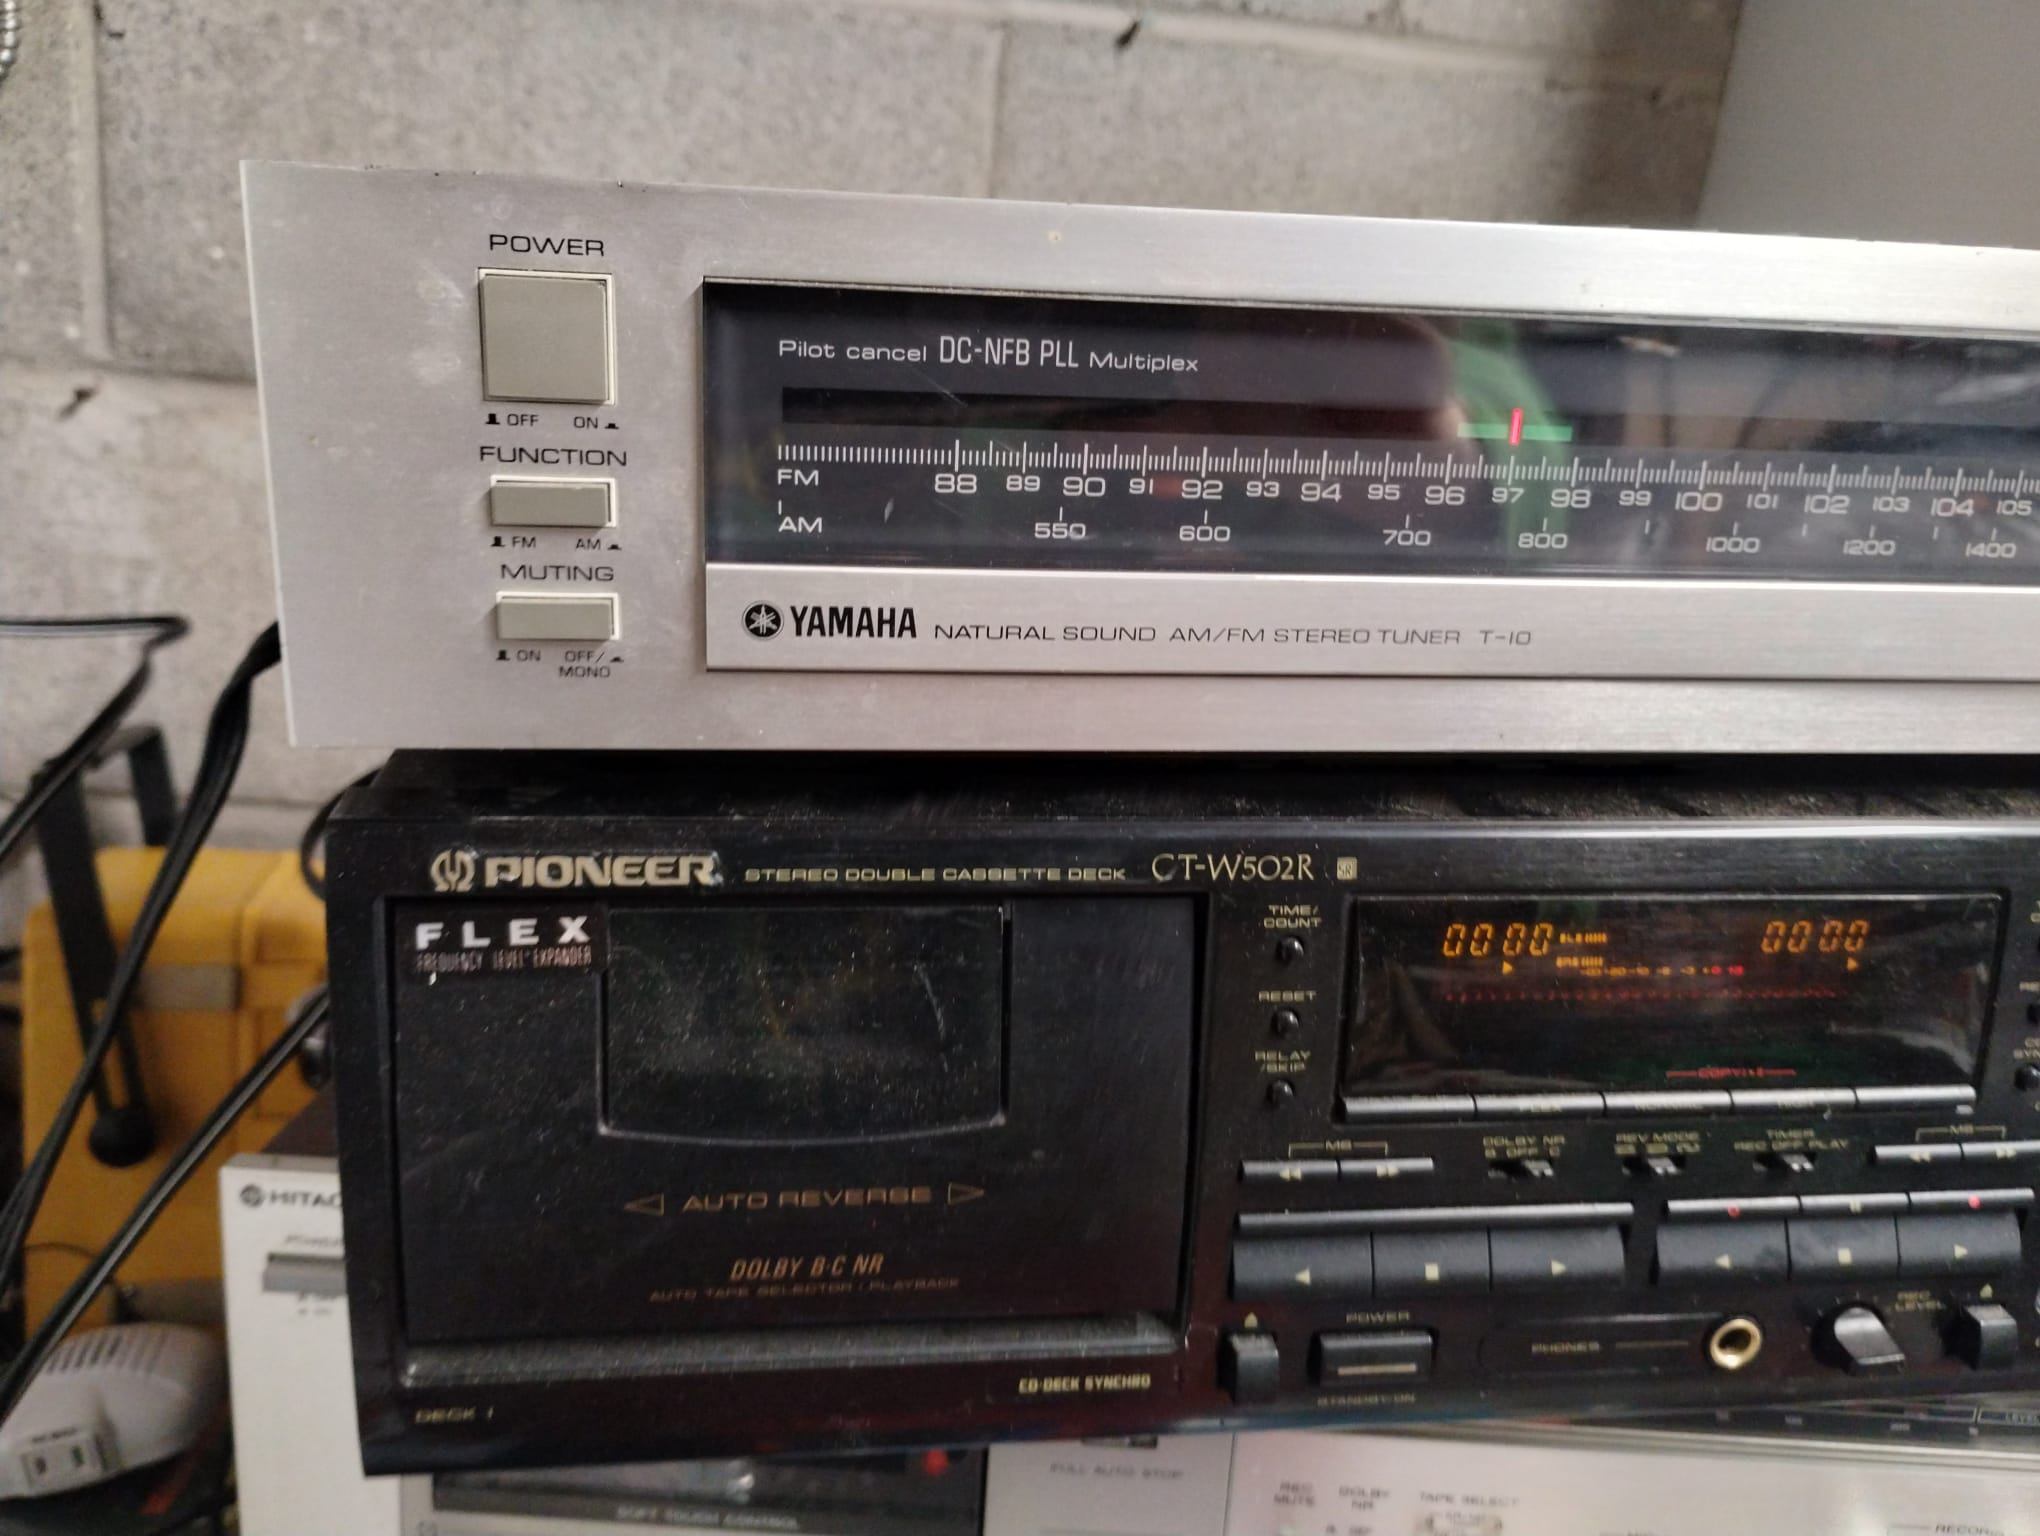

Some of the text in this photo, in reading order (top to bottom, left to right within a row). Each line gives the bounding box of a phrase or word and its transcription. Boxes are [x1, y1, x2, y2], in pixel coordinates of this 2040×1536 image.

[489, 234, 605, 256] POWER
[778, 335, 1199, 374] Pilot cancel DC-NFB PLL Multiplex
[507, 413, 539, 427] OFF
[573, 416, 598, 429] ON
[479, 446, 628, 467] FUNCTION
[777, 468, 2033, 518] FM 88 89 90 91 92 93 94 95 96 97 98 99 100 101 102 103 104 105
[512, 536, 537, 549] FM
[575, 538, 601, 550] AM
[778, 516, 2017, 559] AM 550 600 700 800 1000 1200 1400
[501, 563, 615, 582] MUTING
[790, 605, 1532, 646] YAMAHA NATURAL SOUND AM/FM STEREO TUNER T-10
[516, 649, 542, 662] ON
[564, 650, 606, 664] OFF/
[558, 666, 612, 679] MONO
[484, 853, 1315, 889] PIONEER STEREO DOUBLE CASSETTE DECK CT-W502R
[1263, 916, 1323, 929] COUNT
[415, 915, 592, 950] FLEX
[1258, 990, 1318, 1002] RESET
[682, 1186, 932, 1213] AUTO REVERSE
[728, 1258, 804, 1281] DOLBY
[852, 1253, 885, 1275] NR
[1084, 1373, 1152, 1392] SYNCHRO
